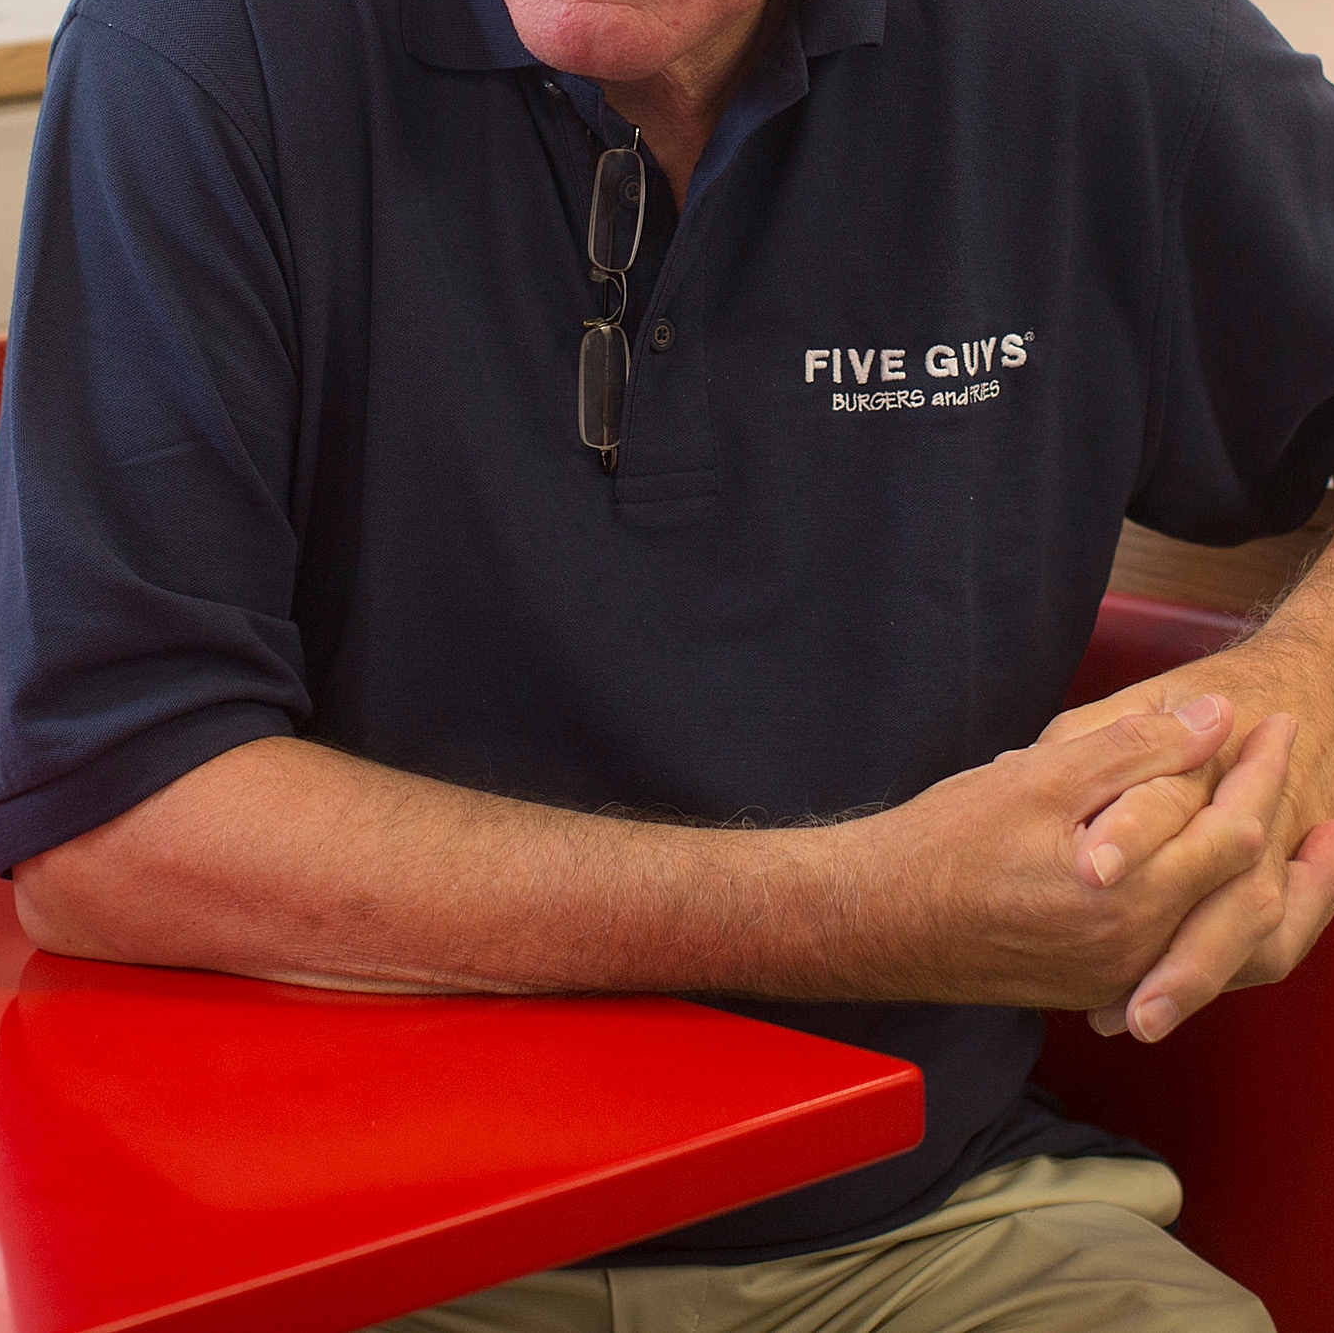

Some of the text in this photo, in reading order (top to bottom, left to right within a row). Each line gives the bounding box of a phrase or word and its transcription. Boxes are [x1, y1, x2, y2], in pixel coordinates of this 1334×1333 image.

[804, 348, 907, 385] FIVE
[832, 389, 926, 412] BURGERS
[931, 386, 969, 407] and
